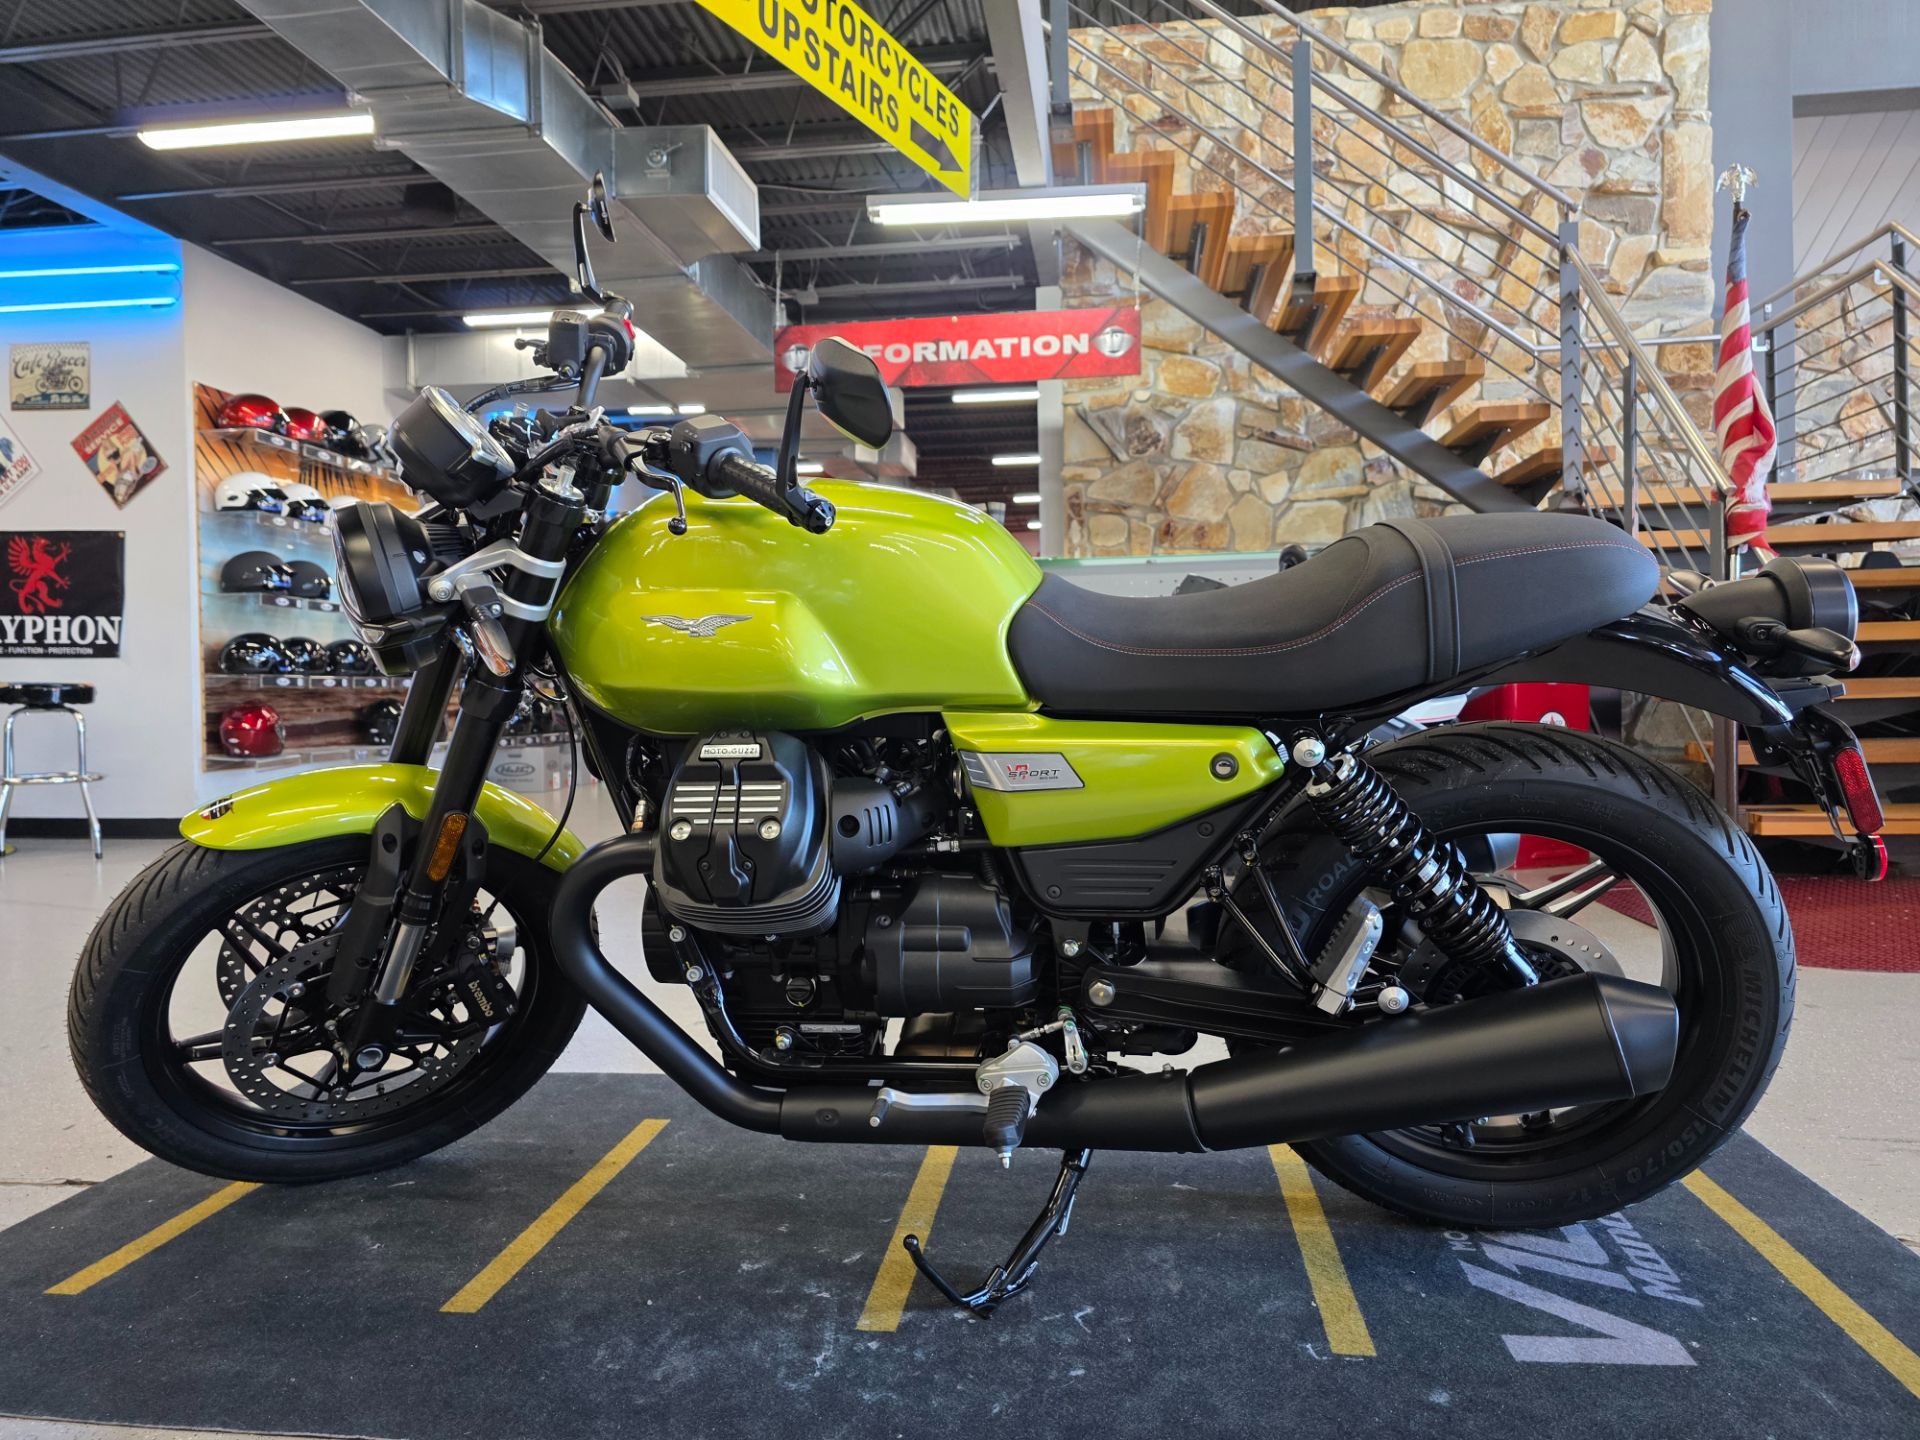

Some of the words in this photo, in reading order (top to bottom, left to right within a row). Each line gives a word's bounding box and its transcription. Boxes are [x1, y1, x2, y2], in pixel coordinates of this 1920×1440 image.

[758, 0, 900, 133] UPSTAIRS
[84, 417, 124, 454] SERVICE
[0, 615, 122, 645] YPHON
[8, 646, 44, 655] FUNCTION
[48, 646, 94, 655] PROTECTION
[731, 747, 759, 755] GUZZI
[1008, 769, 1061, 778] SPORT
[468, 980, 494, 1017] brembo
[1714, 969, 1764, 1114] MICHELIN
